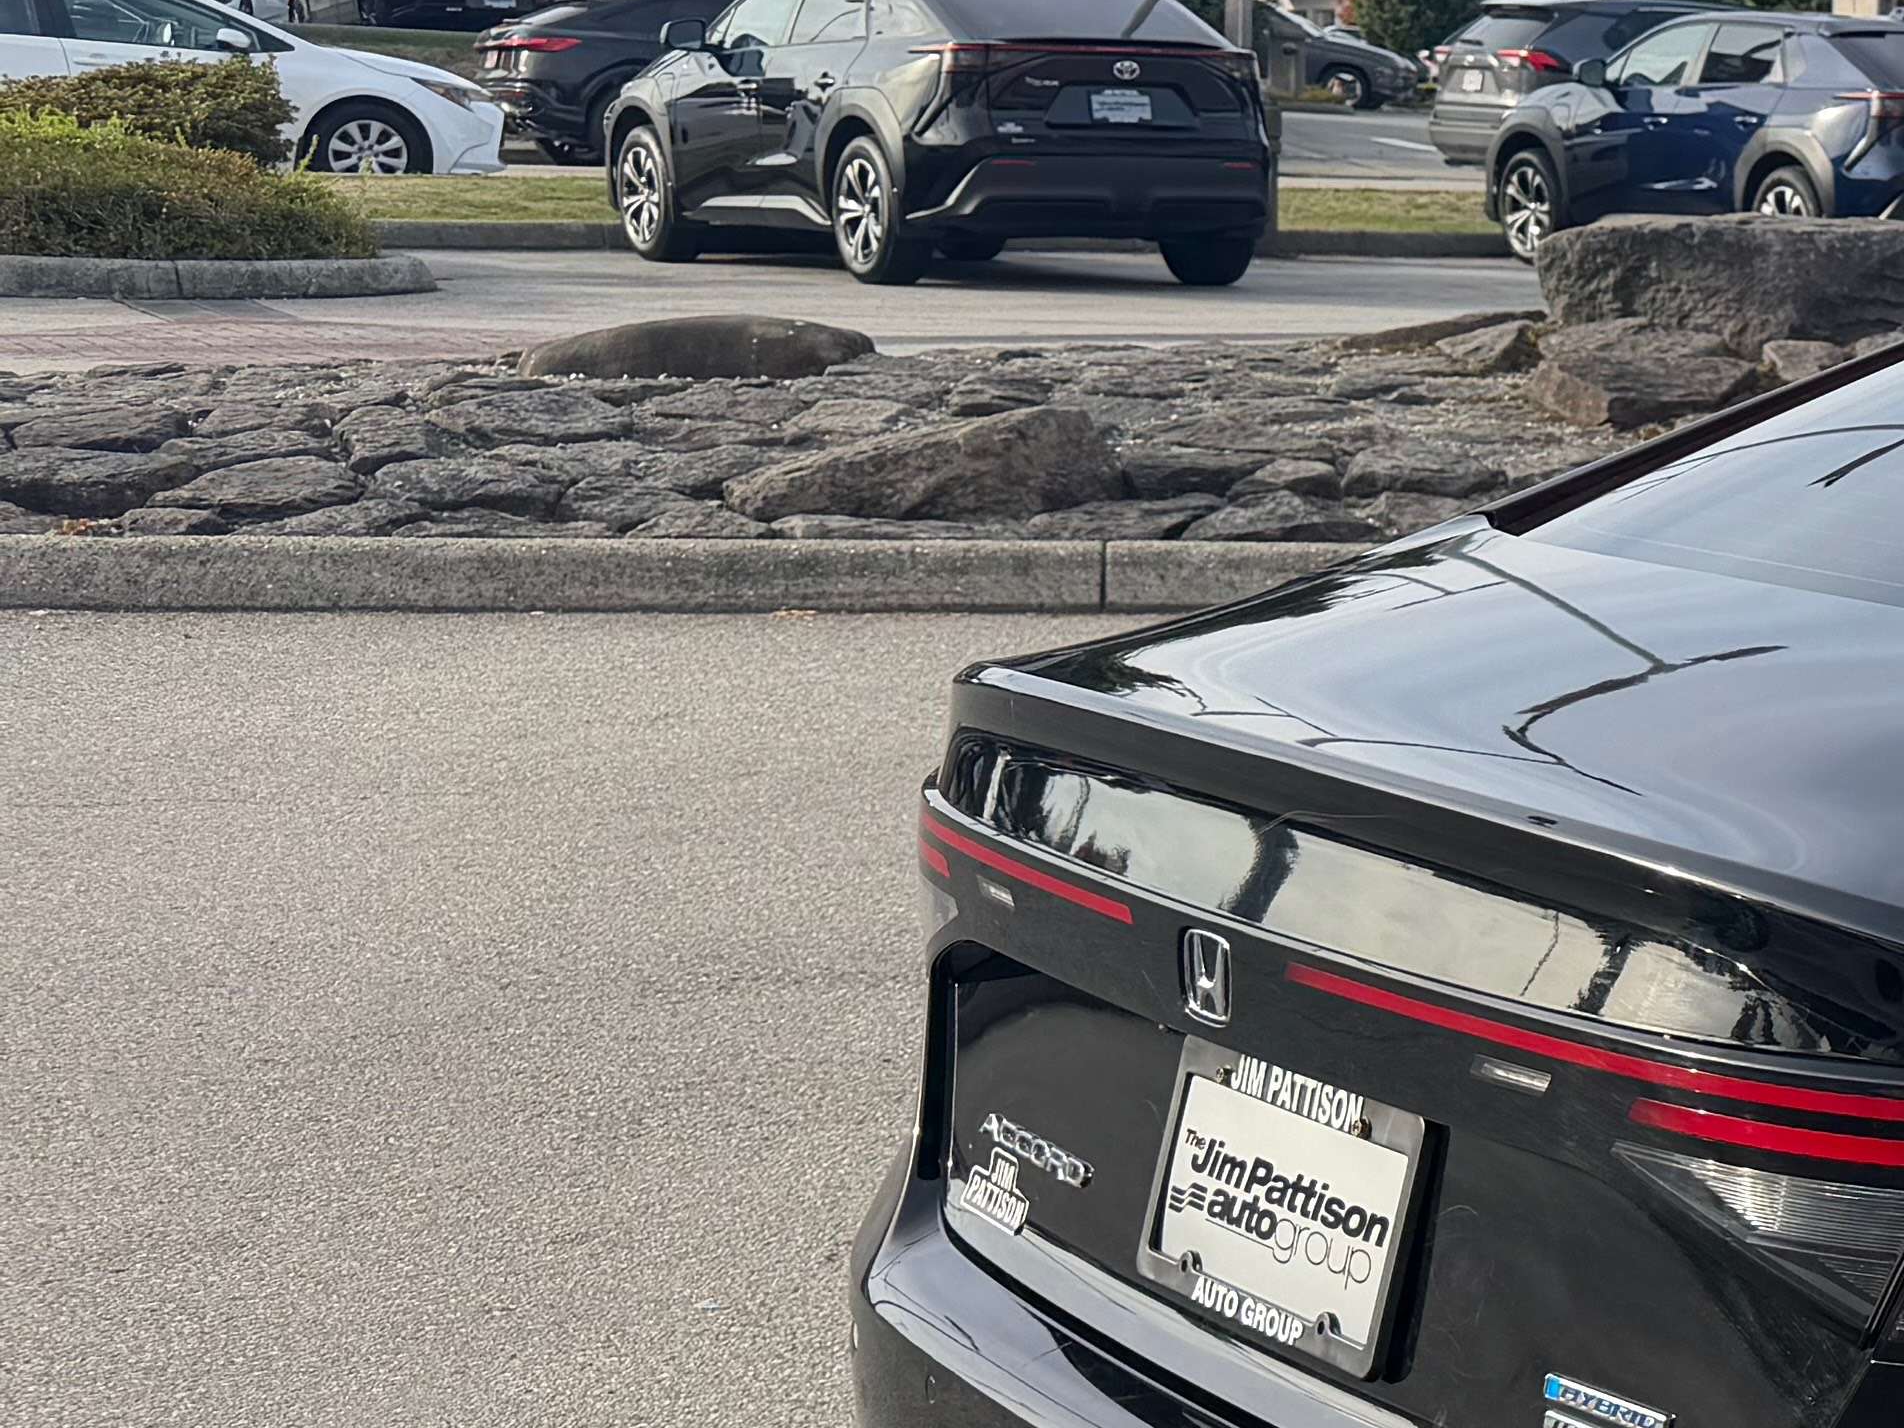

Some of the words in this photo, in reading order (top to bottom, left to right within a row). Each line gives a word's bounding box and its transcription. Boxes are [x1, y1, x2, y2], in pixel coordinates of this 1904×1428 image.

[1230, 1054, 1268, 1098] JIM
[1266, 1067, 1364, 1134] PATTISON
[979, 1113, 1088, 1188] ACCORD
[1185, 1128, 1206, 1151] The
[966, 1174, 1025, 1227] PATTISON
[990, 1158, 1016, 1191] JIM
[1192, 1276, 1239, 1318] AUTO
[1241, 1296, 1304, 1346] GROUP
